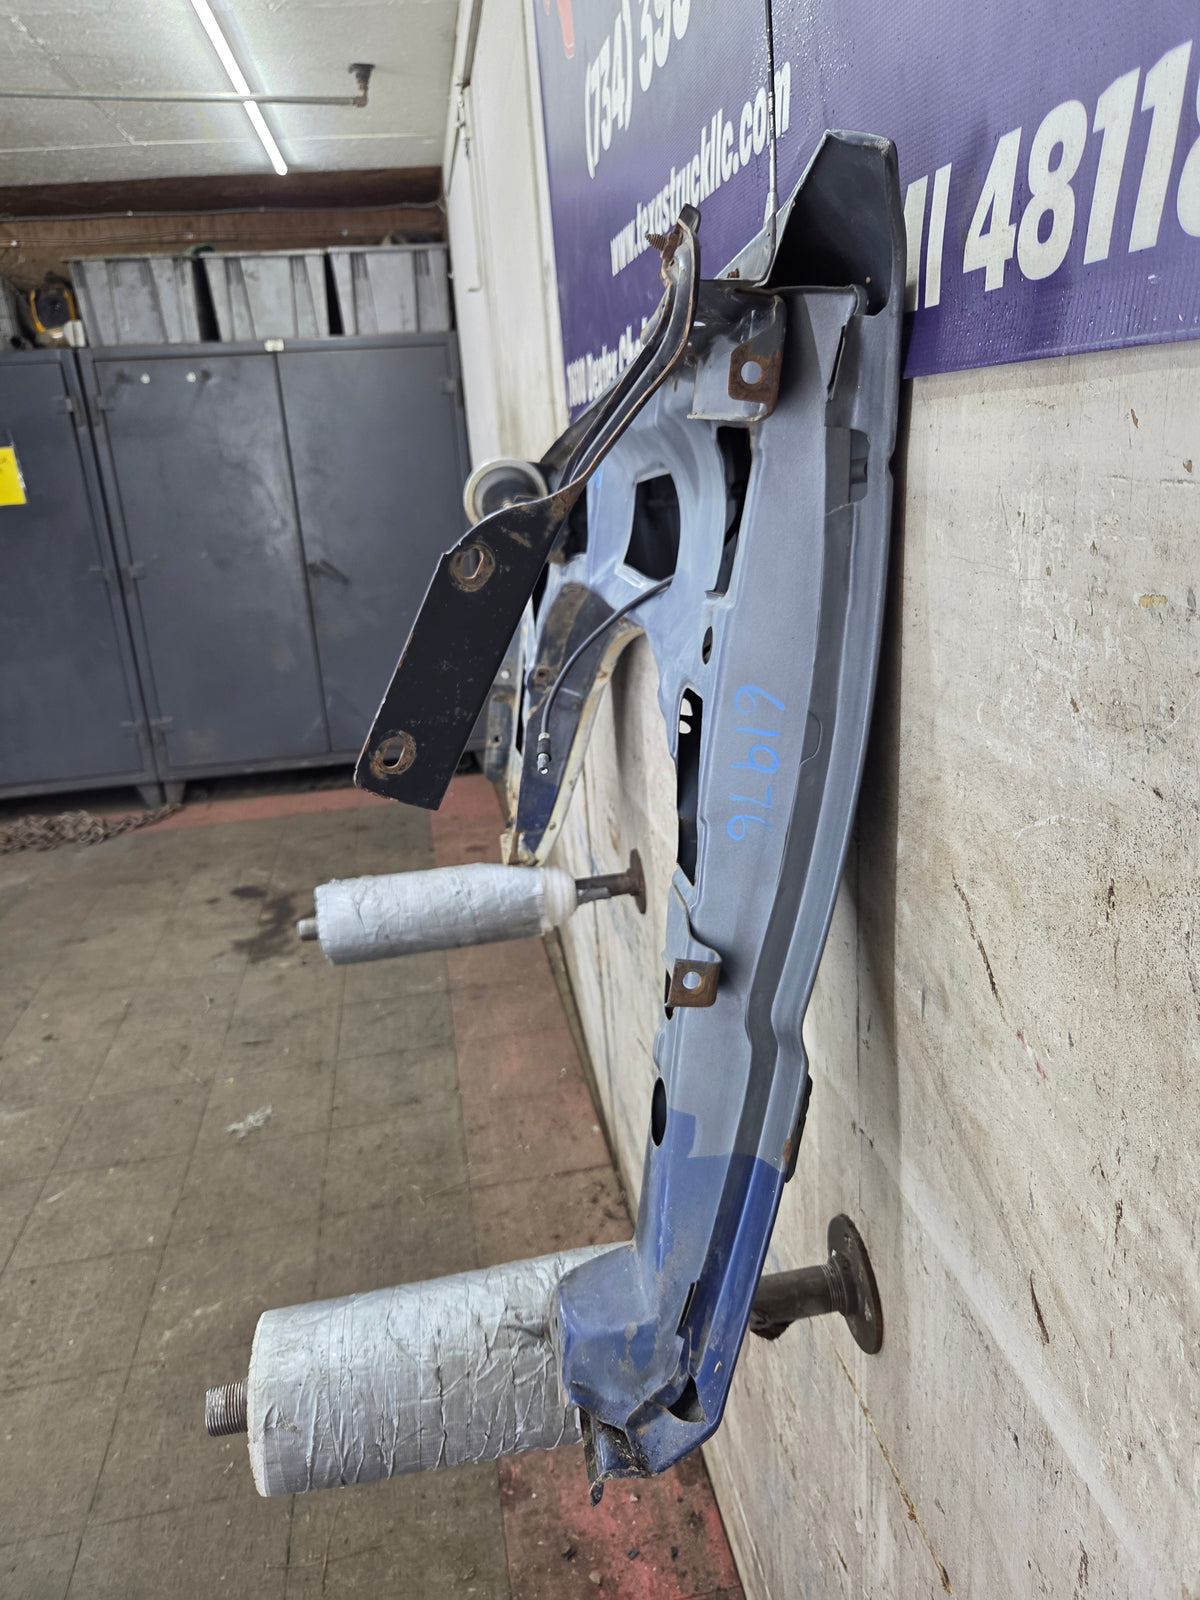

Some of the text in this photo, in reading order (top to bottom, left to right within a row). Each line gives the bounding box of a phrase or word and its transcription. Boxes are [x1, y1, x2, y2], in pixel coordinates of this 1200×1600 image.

[585, 0, 633, 180] (734)
[610, 61, 791, 277] www.texastruckllc.com
[727, 684, 786, 841] 61976
